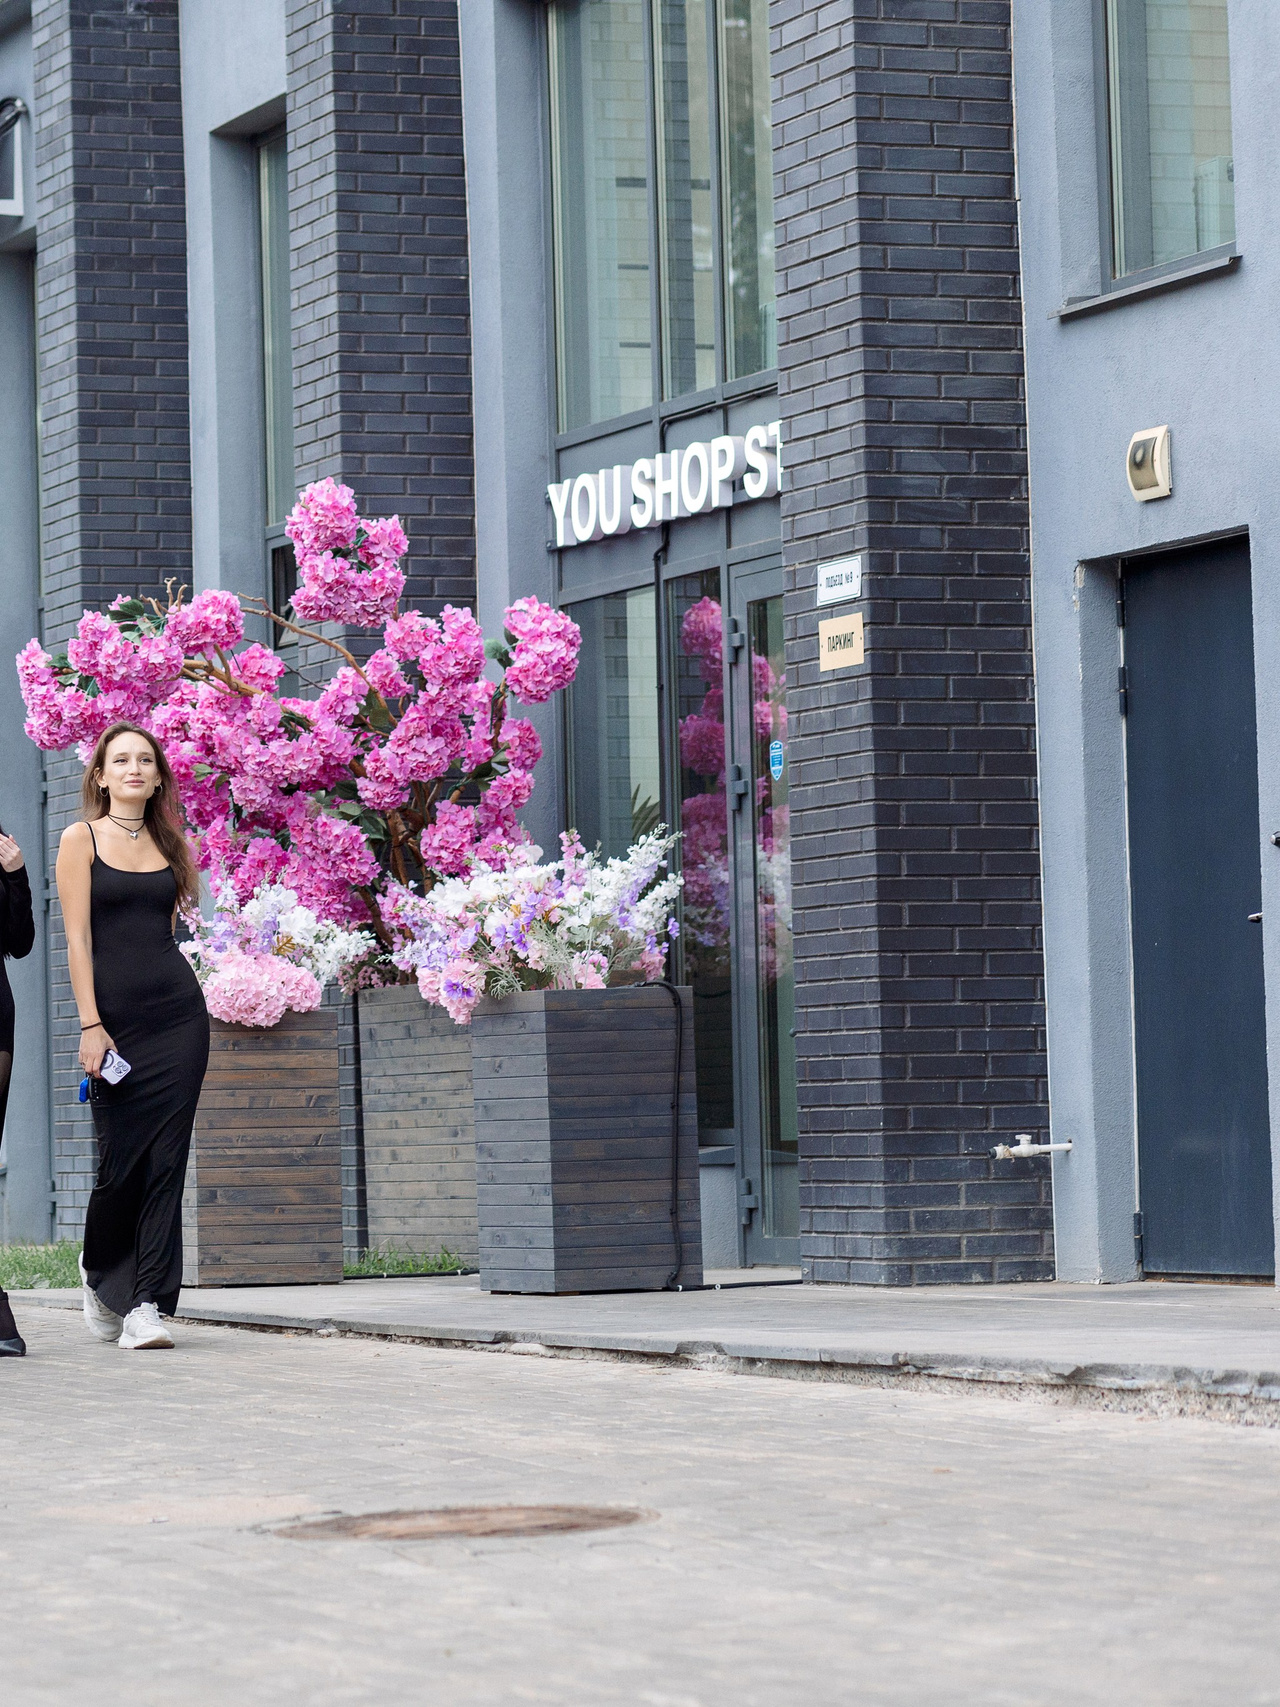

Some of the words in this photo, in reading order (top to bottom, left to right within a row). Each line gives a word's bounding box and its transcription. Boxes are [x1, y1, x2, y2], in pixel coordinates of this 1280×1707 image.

[547, 465, 626, 547] YOU
[630, 435, 738, 528] SHOP
[828, 632, 854, 652] ПАРКИНГ
